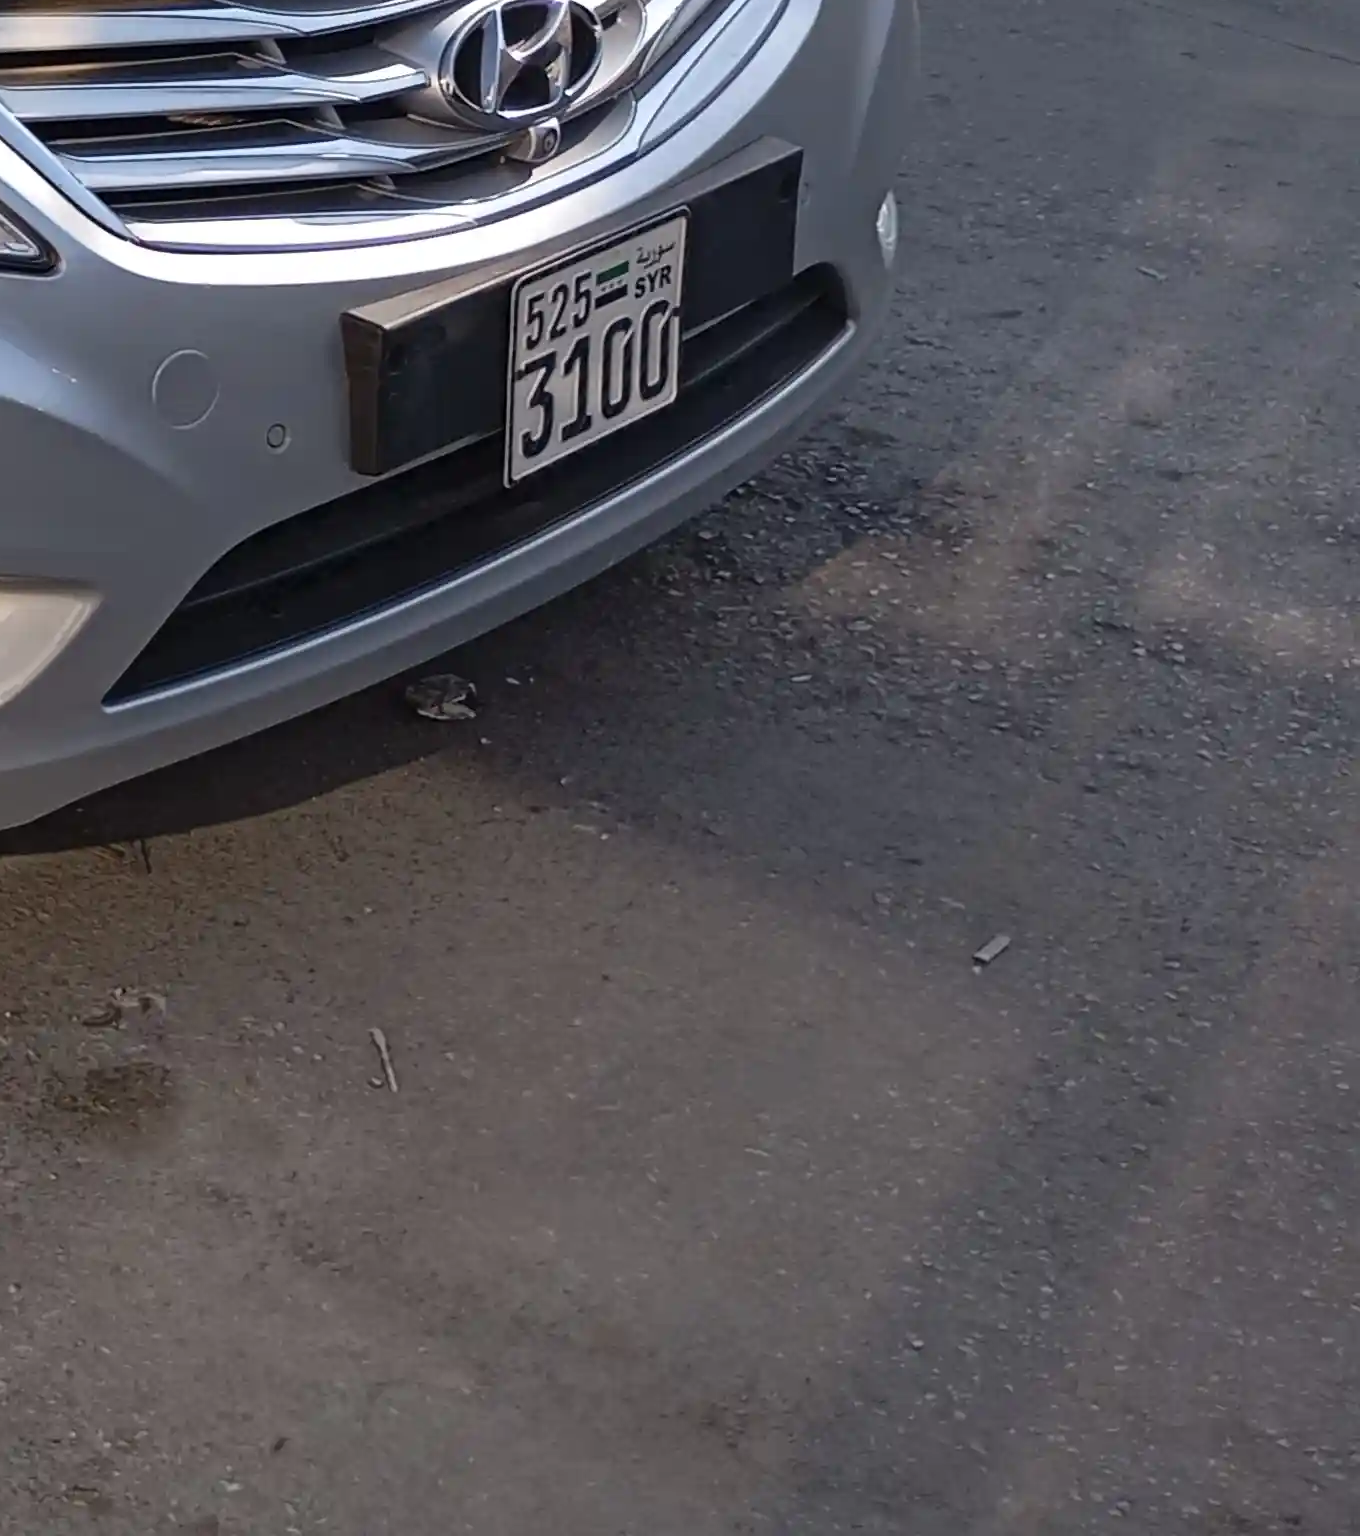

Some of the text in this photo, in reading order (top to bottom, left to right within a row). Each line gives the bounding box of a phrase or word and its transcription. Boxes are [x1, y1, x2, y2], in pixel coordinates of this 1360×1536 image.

[634, 265, 672, 299] SYR
[636, 242, 676, 270] سورية
[525, 270, 592, 351] 525
[520, 298, 671, 458] 3100
